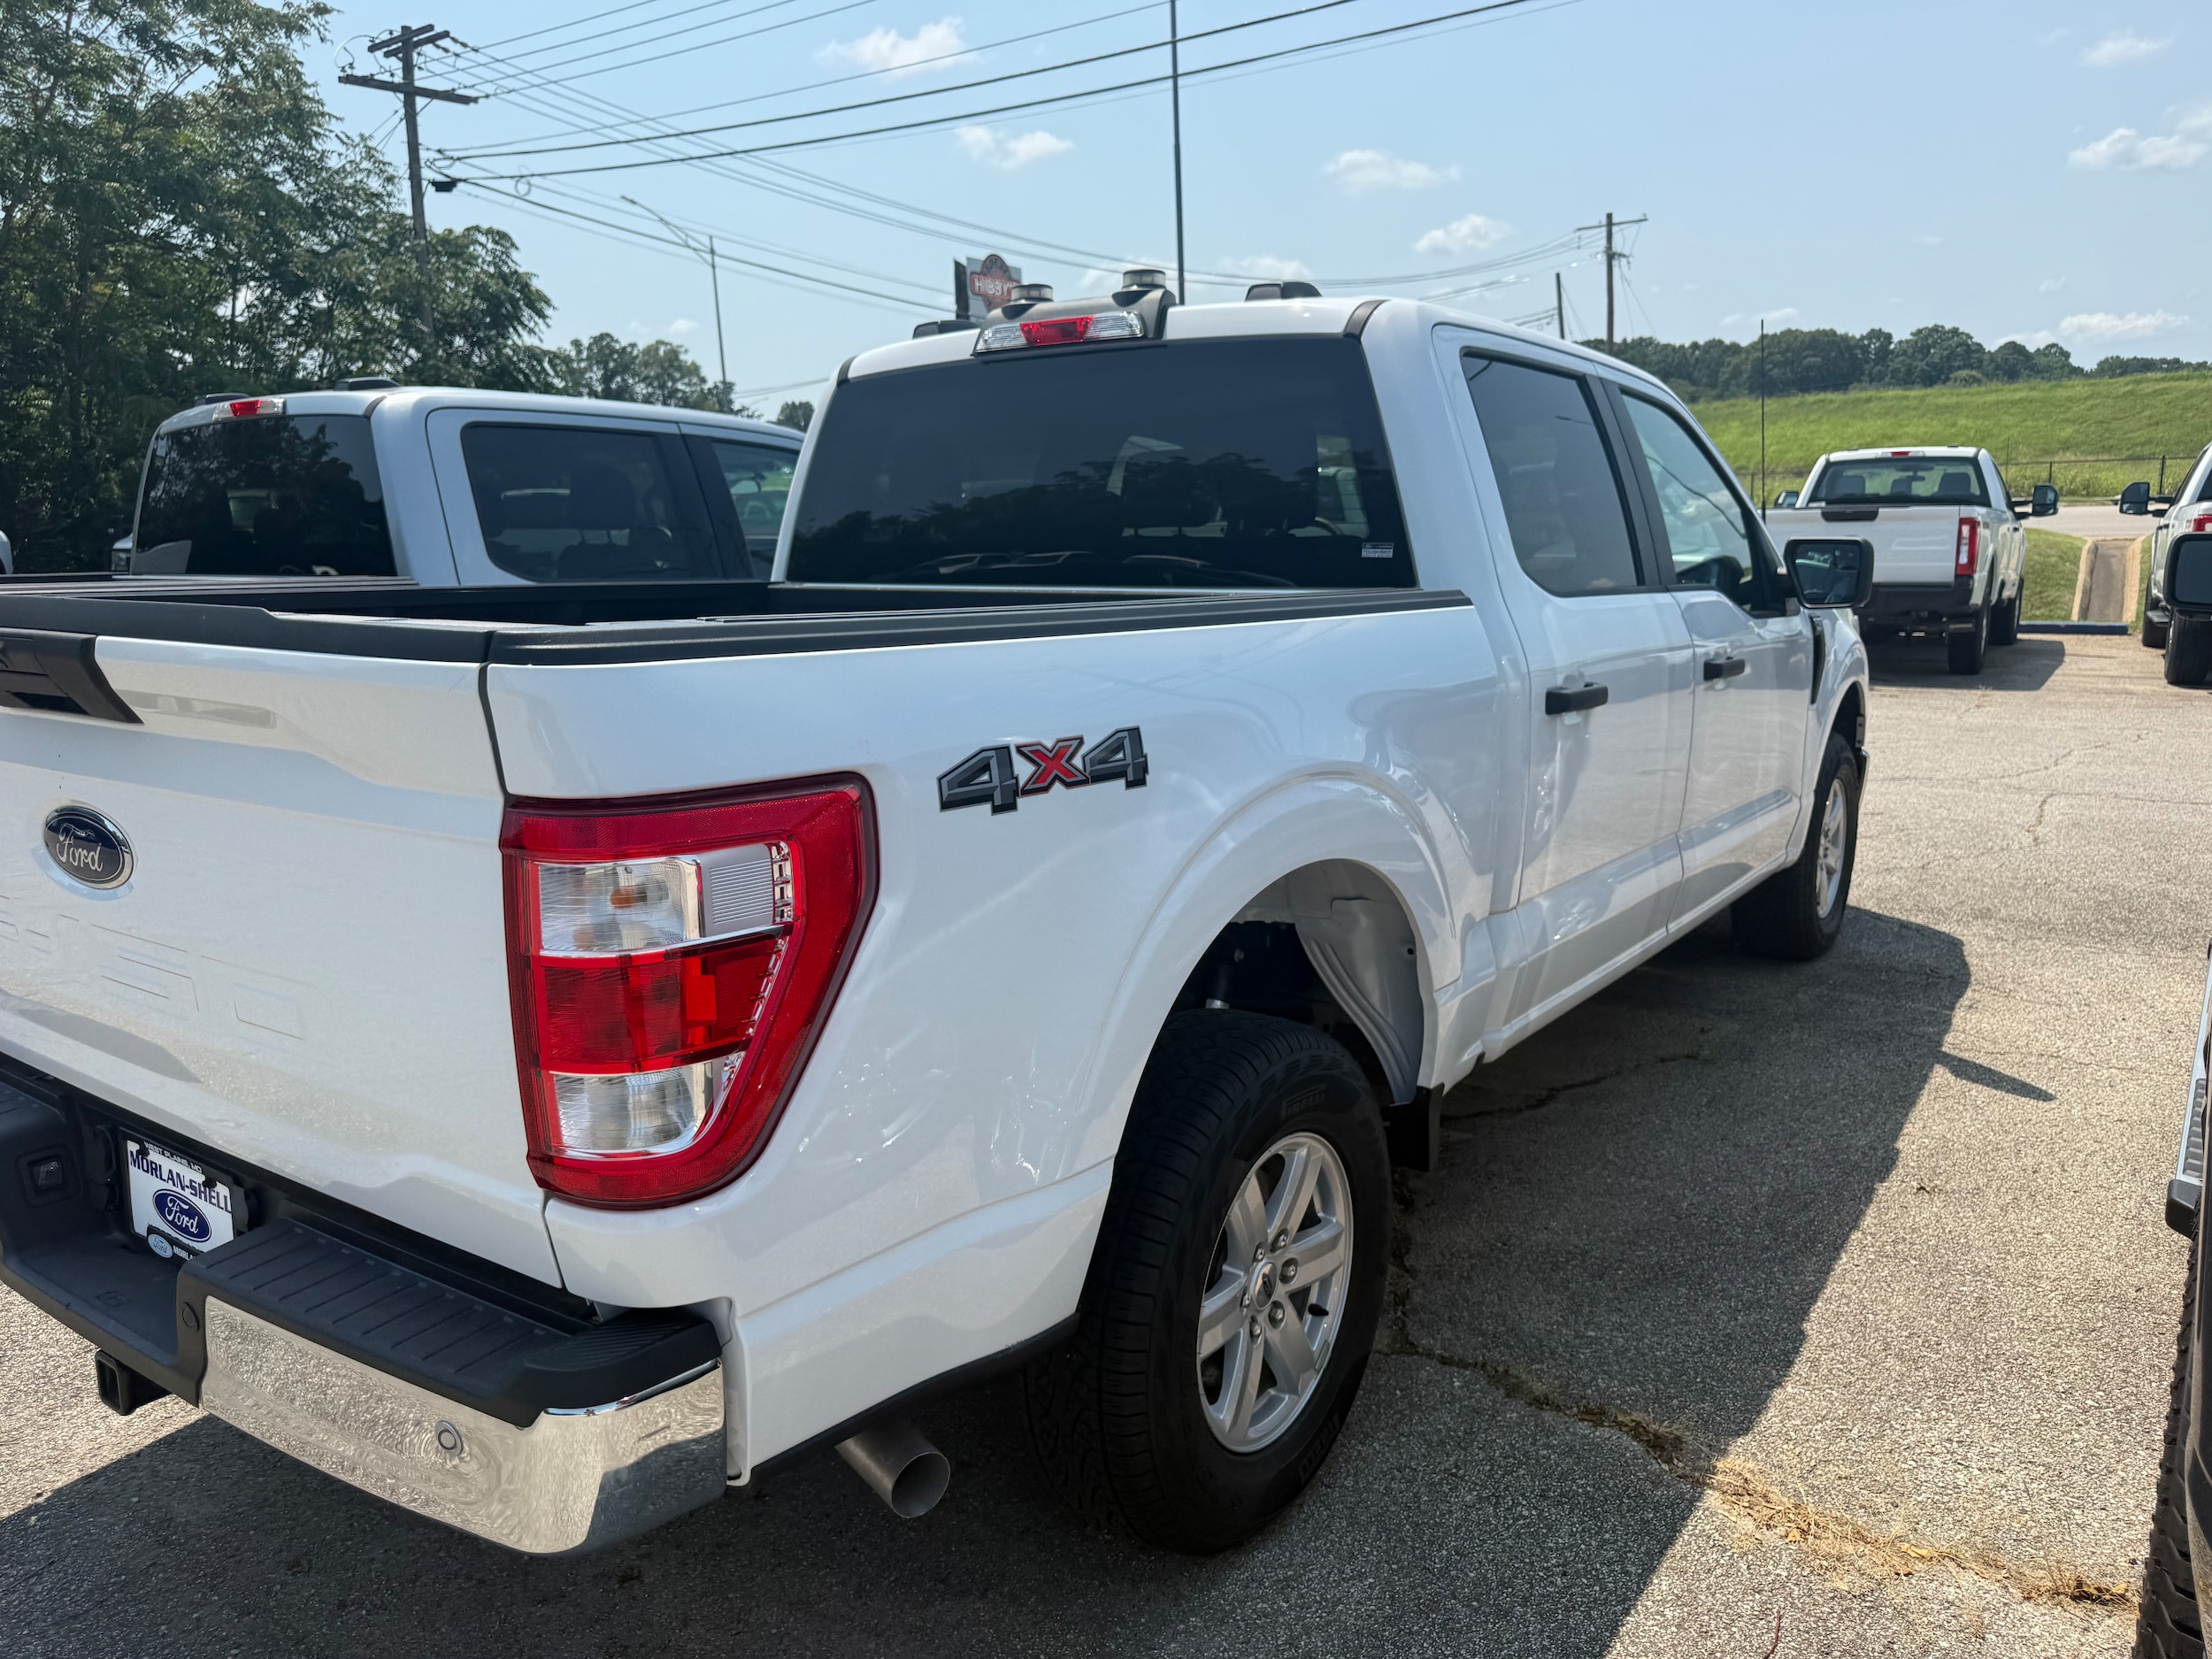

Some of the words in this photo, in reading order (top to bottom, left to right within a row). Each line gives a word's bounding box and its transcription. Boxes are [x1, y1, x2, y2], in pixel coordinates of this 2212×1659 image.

[56, 823, 104, 872] Ford
[143, 1141, 164, 1156] WEST
[190, 1161, 203, 1174] MO
[129, 1150, 233, 1214] MORLAN-SHELL
[165, 1195, 199, 1234] Ford
[152, 1237, 169, 1255] Ford
[173, 1245, 196, 1261] MORLA
